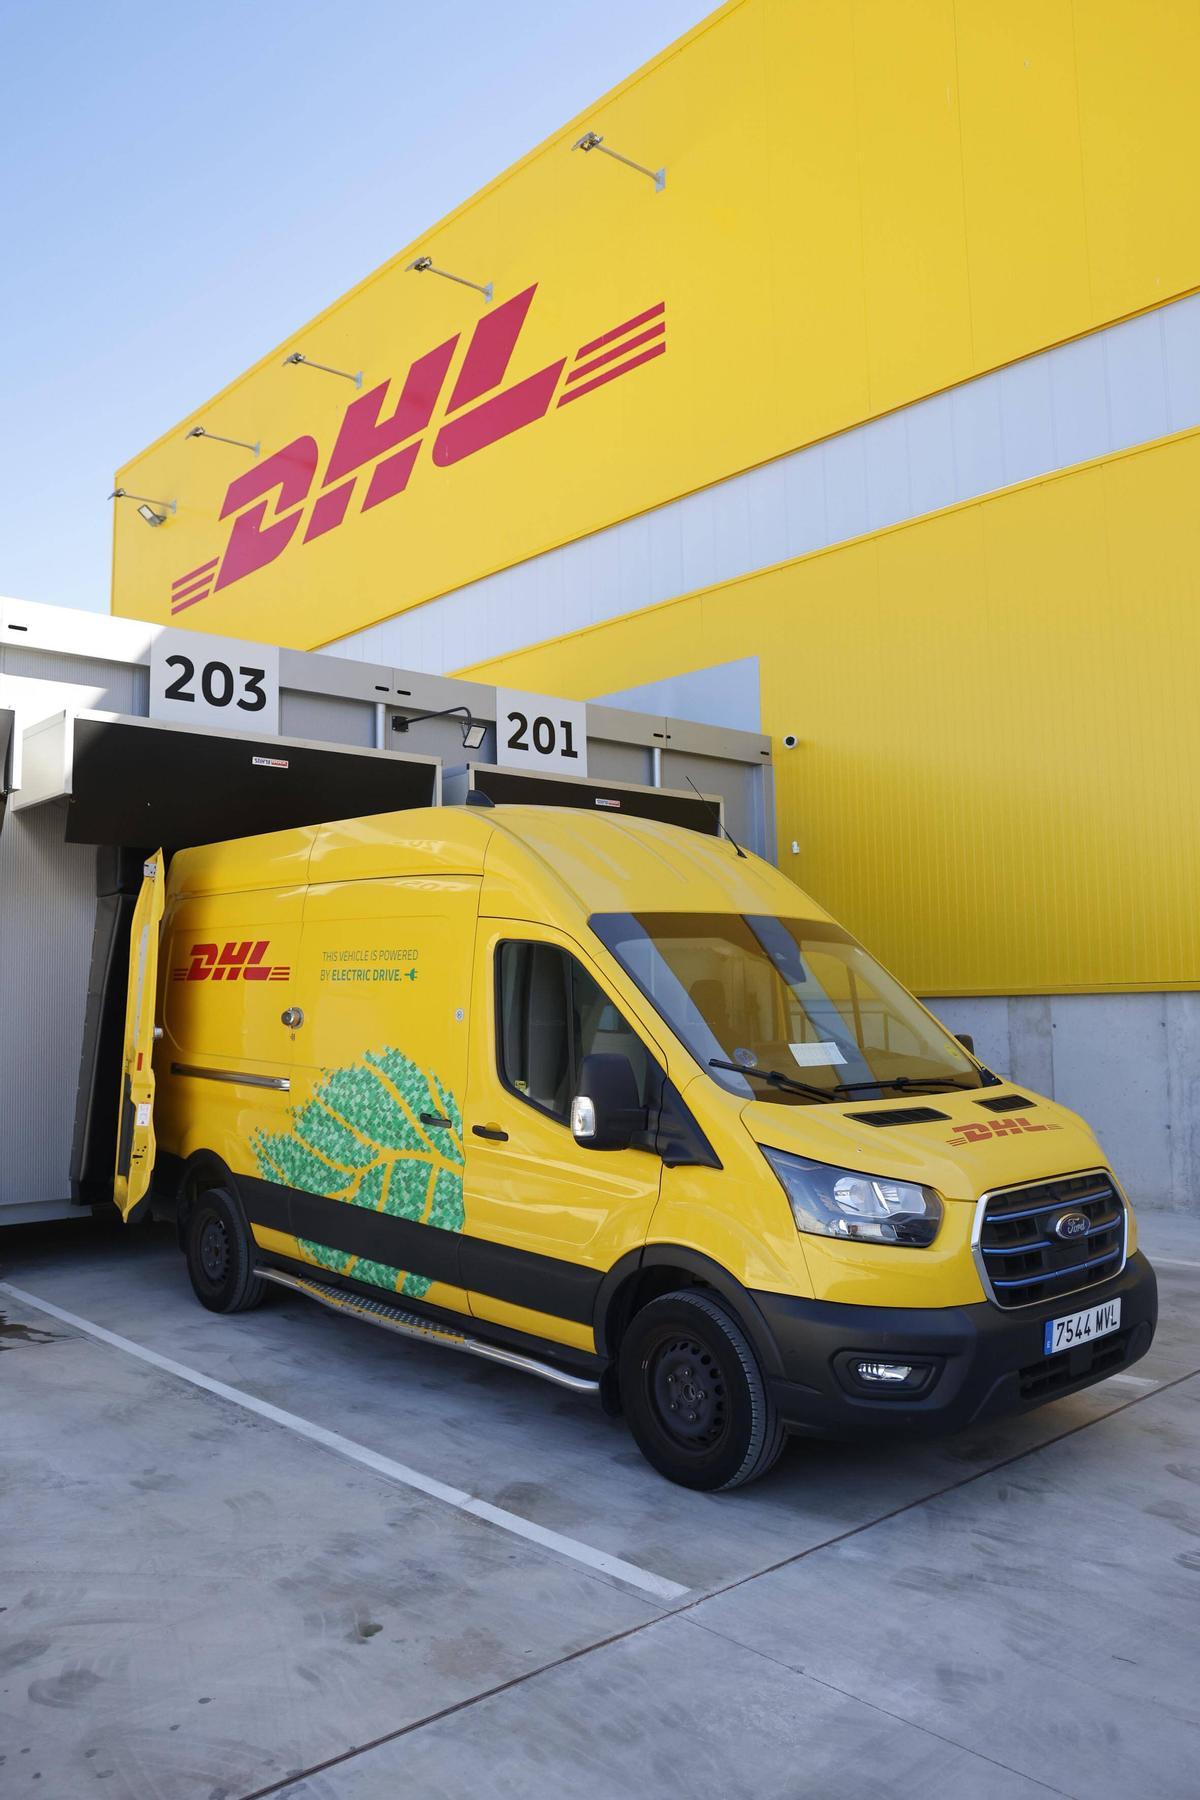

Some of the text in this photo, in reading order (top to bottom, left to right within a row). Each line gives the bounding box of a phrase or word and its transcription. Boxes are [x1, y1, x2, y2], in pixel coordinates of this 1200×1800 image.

[214, 283, 567, 592] DHL
[165, 655, 267, 711] 203
[507, 712, 578, 758] 201
[186, 941, 272, 981] DHL
[320, 969, 402, 981] BY ELECTRIC DRIVE.
[322, 949, 419, 961] THIS VEHICLE IS POWERED
[952, 1117, 1048, 1143] DHL
[1067, 1217, 1086, 1234] Ford
[1056, 1313, 1091, 1347] 7544
[1095, 1304, 1118, 1333] MVL
